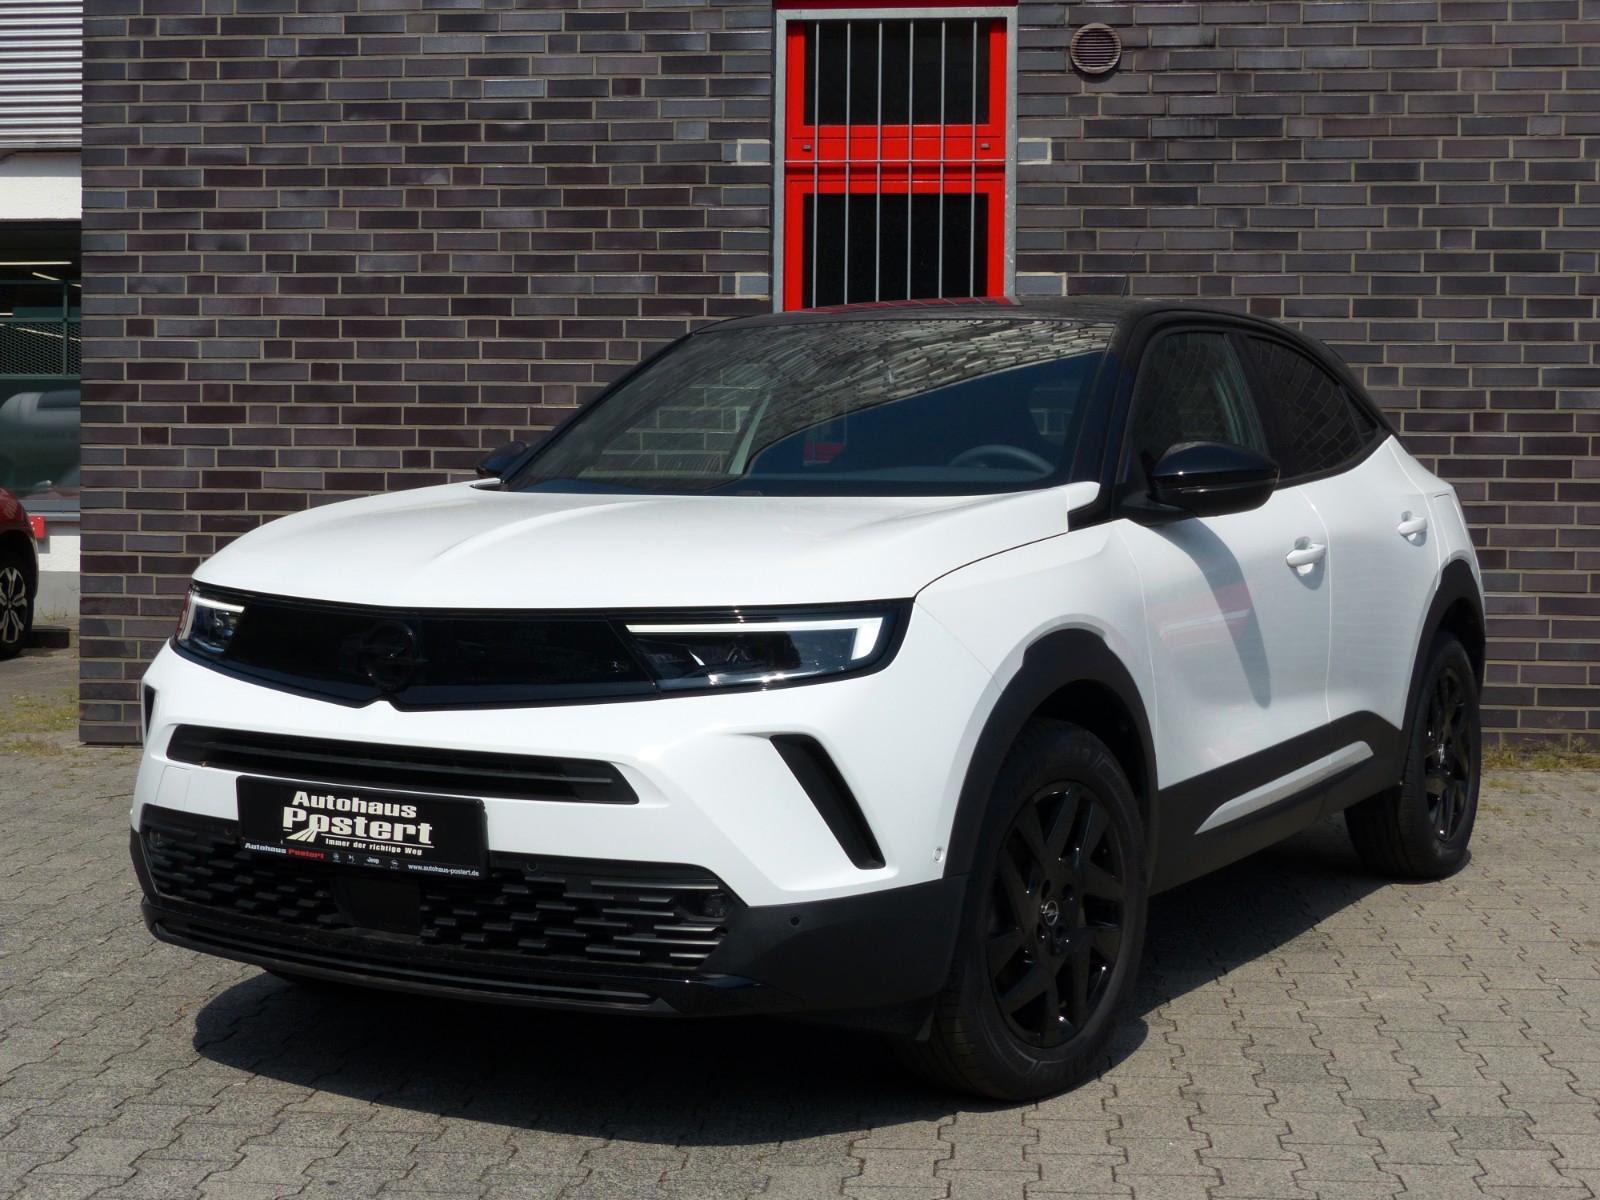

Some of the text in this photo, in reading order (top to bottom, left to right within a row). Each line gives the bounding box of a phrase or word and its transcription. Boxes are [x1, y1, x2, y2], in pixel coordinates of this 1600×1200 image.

[292, 791, 417, 818] Autohaus
[282, 806, 433, 844] Postert
[245, 842, 325, 859] Autohaus Postert
[325, 838, 350, 848] Immer
[369, 843, 402, 854] richtige
[404, 847, 423, 857] Weg
[408, 863, 480, 877] www.autohaus-postert.de
